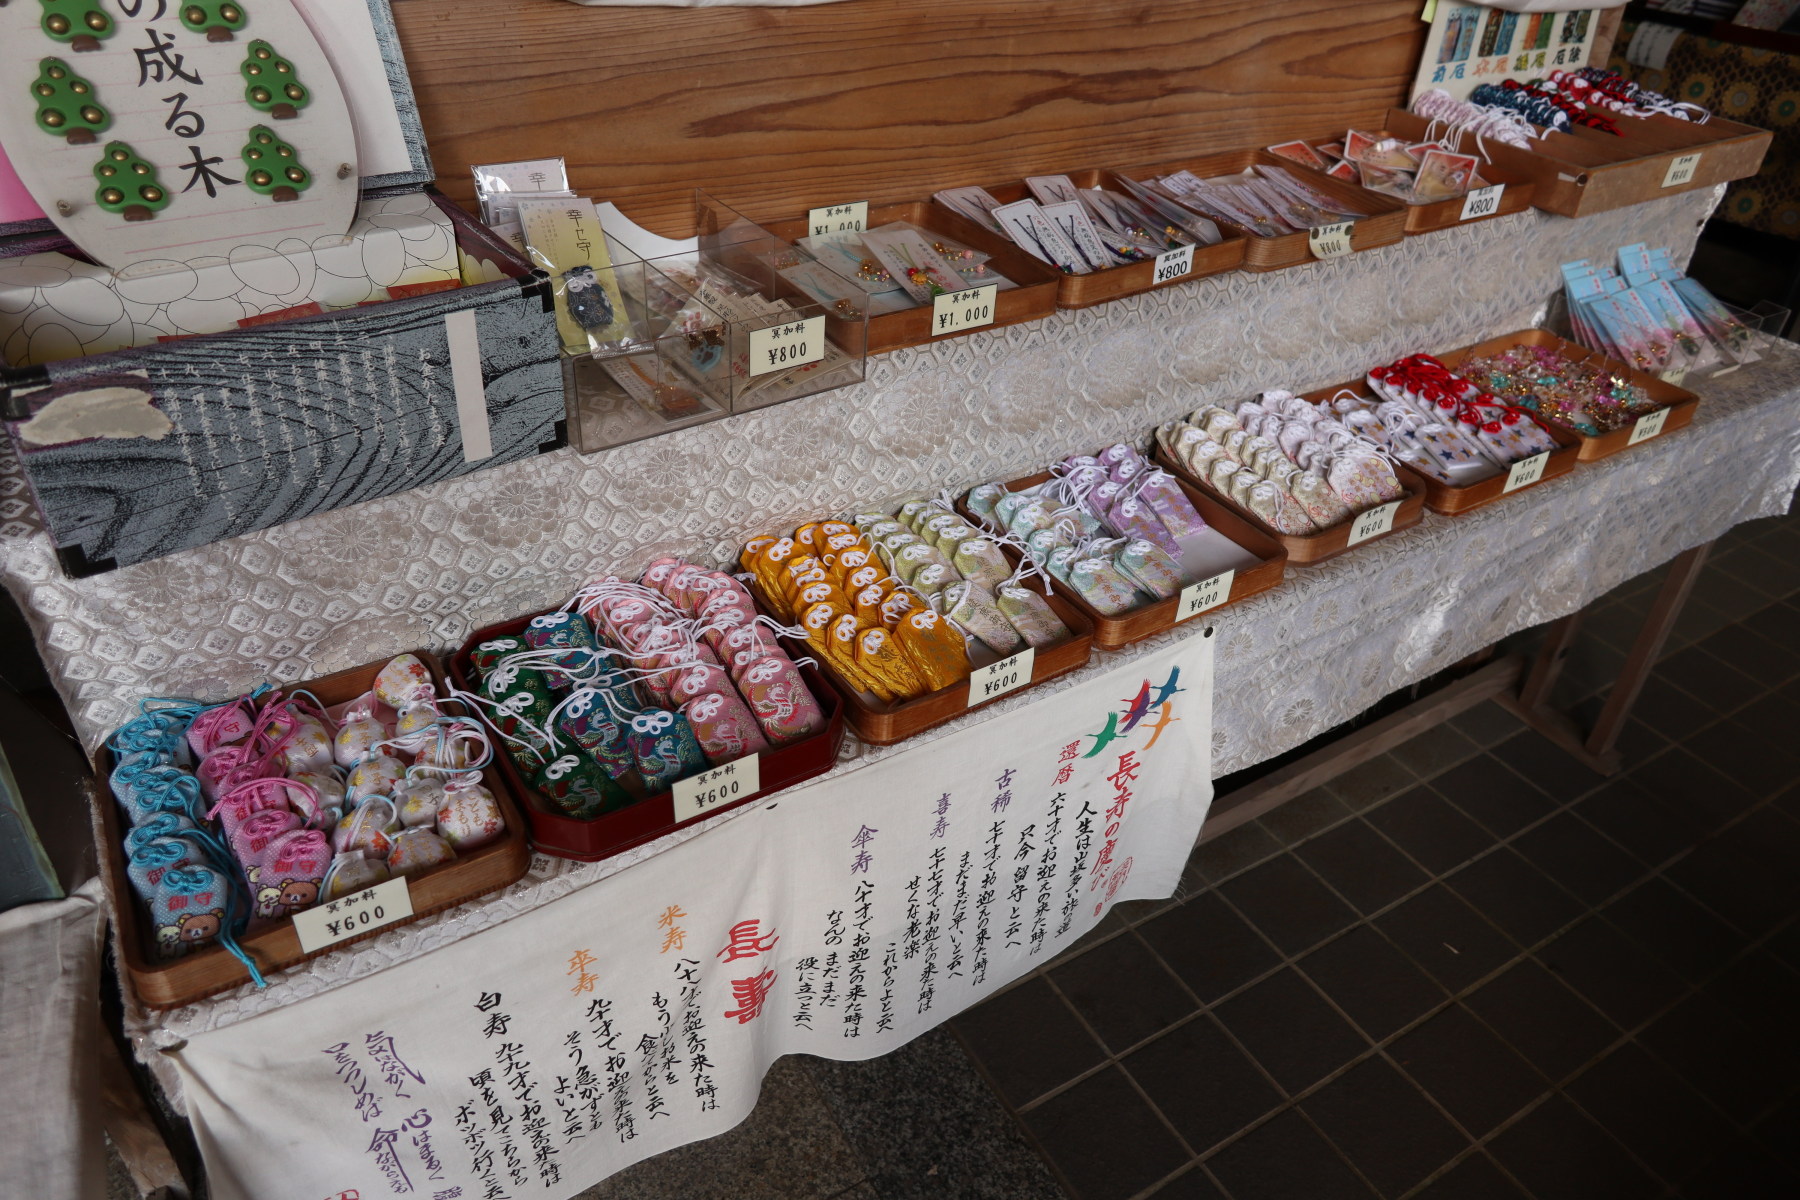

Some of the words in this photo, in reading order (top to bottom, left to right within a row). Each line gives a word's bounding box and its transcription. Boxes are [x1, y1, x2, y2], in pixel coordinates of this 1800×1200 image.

[1552, 46, 1582, 66] 厄除
[826, 206, 853, 218] 冥加料
[1469, 197, 1494, 215] ¥800
[1319, 240, 1341, 255] ¥800
[1158, 260, 1188, 281] ¥800
[952, 289, 981, 304] 冥加料
[771, 322, 806, 339] 冥加料
[768, 341, 808, 366] ¥800
[419, 347, 446, 449] お金がたまる法
[1514, 469, 1536, 486] ¥600
[1360, 518, 1383, 538] ¥600
[1190, 591, 1218, 612] ¥600
[988, 656, 1018, 676] 冥加料
[984, 671, 1018, 696] ¥600
[1051, 739, 1081, 787] 還暦
[696, 764, 738, 786] 冥加料
[693, 778, 741, 809] ¥600
[990, 768, 1018, 814] 古稀
[930, 793, 952, 840] 喜寿
[1089, 750, 1142, 892] 長寿の慶び
[849, 824, 879, 876] 傘寿
[274, 858, 317, 875] 御守
[168, 891, 214, 912] 御守
[326, 889, 378, 914] 冥加料
[325, 905, 385, 937] ¥600
[657, 904, 688, 955] 米寿
[473, 991, 512, 1040] 白寿
